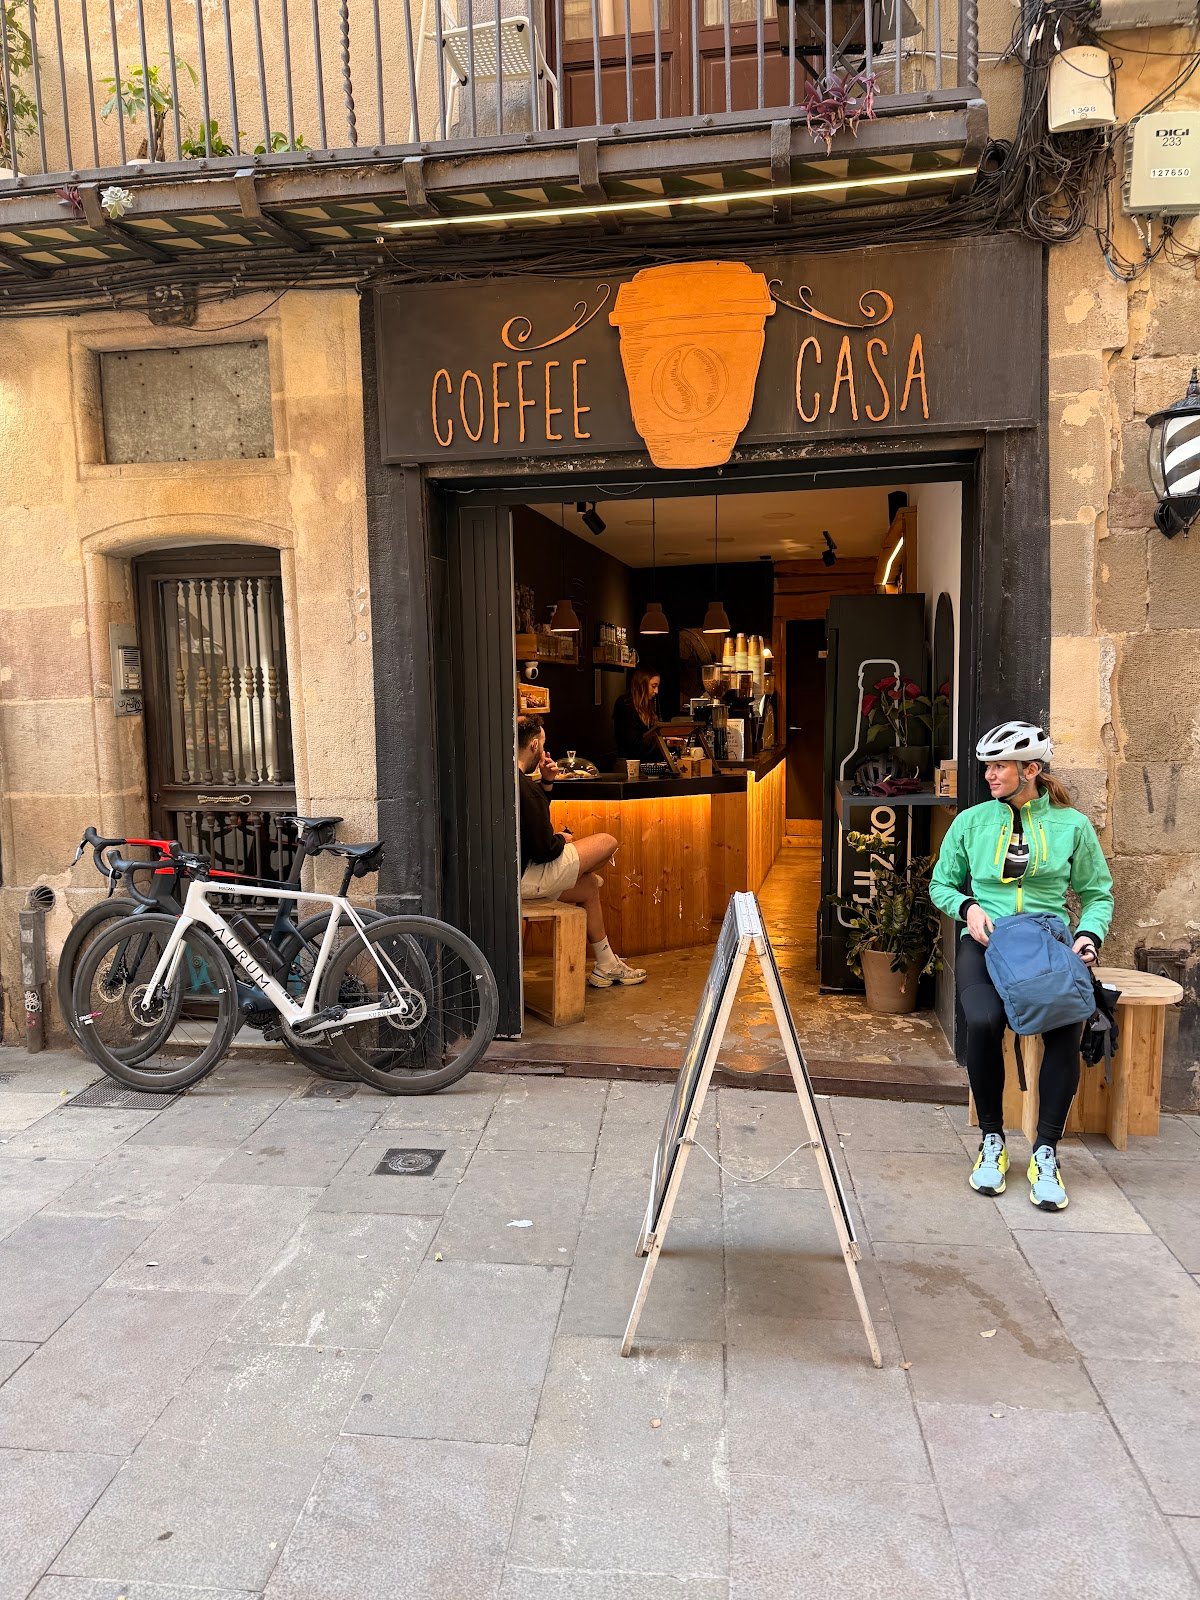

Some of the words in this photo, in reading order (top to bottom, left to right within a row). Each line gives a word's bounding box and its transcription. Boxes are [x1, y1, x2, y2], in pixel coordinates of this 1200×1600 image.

[1155, 128, 1190, 137] DIGI
[1162, 137, 1182, 147] 233
[1152, 169, 1190, 177] 127650
[431, 358, 591, 447] COFFEE
[796, 333, 929, 423] CASA
